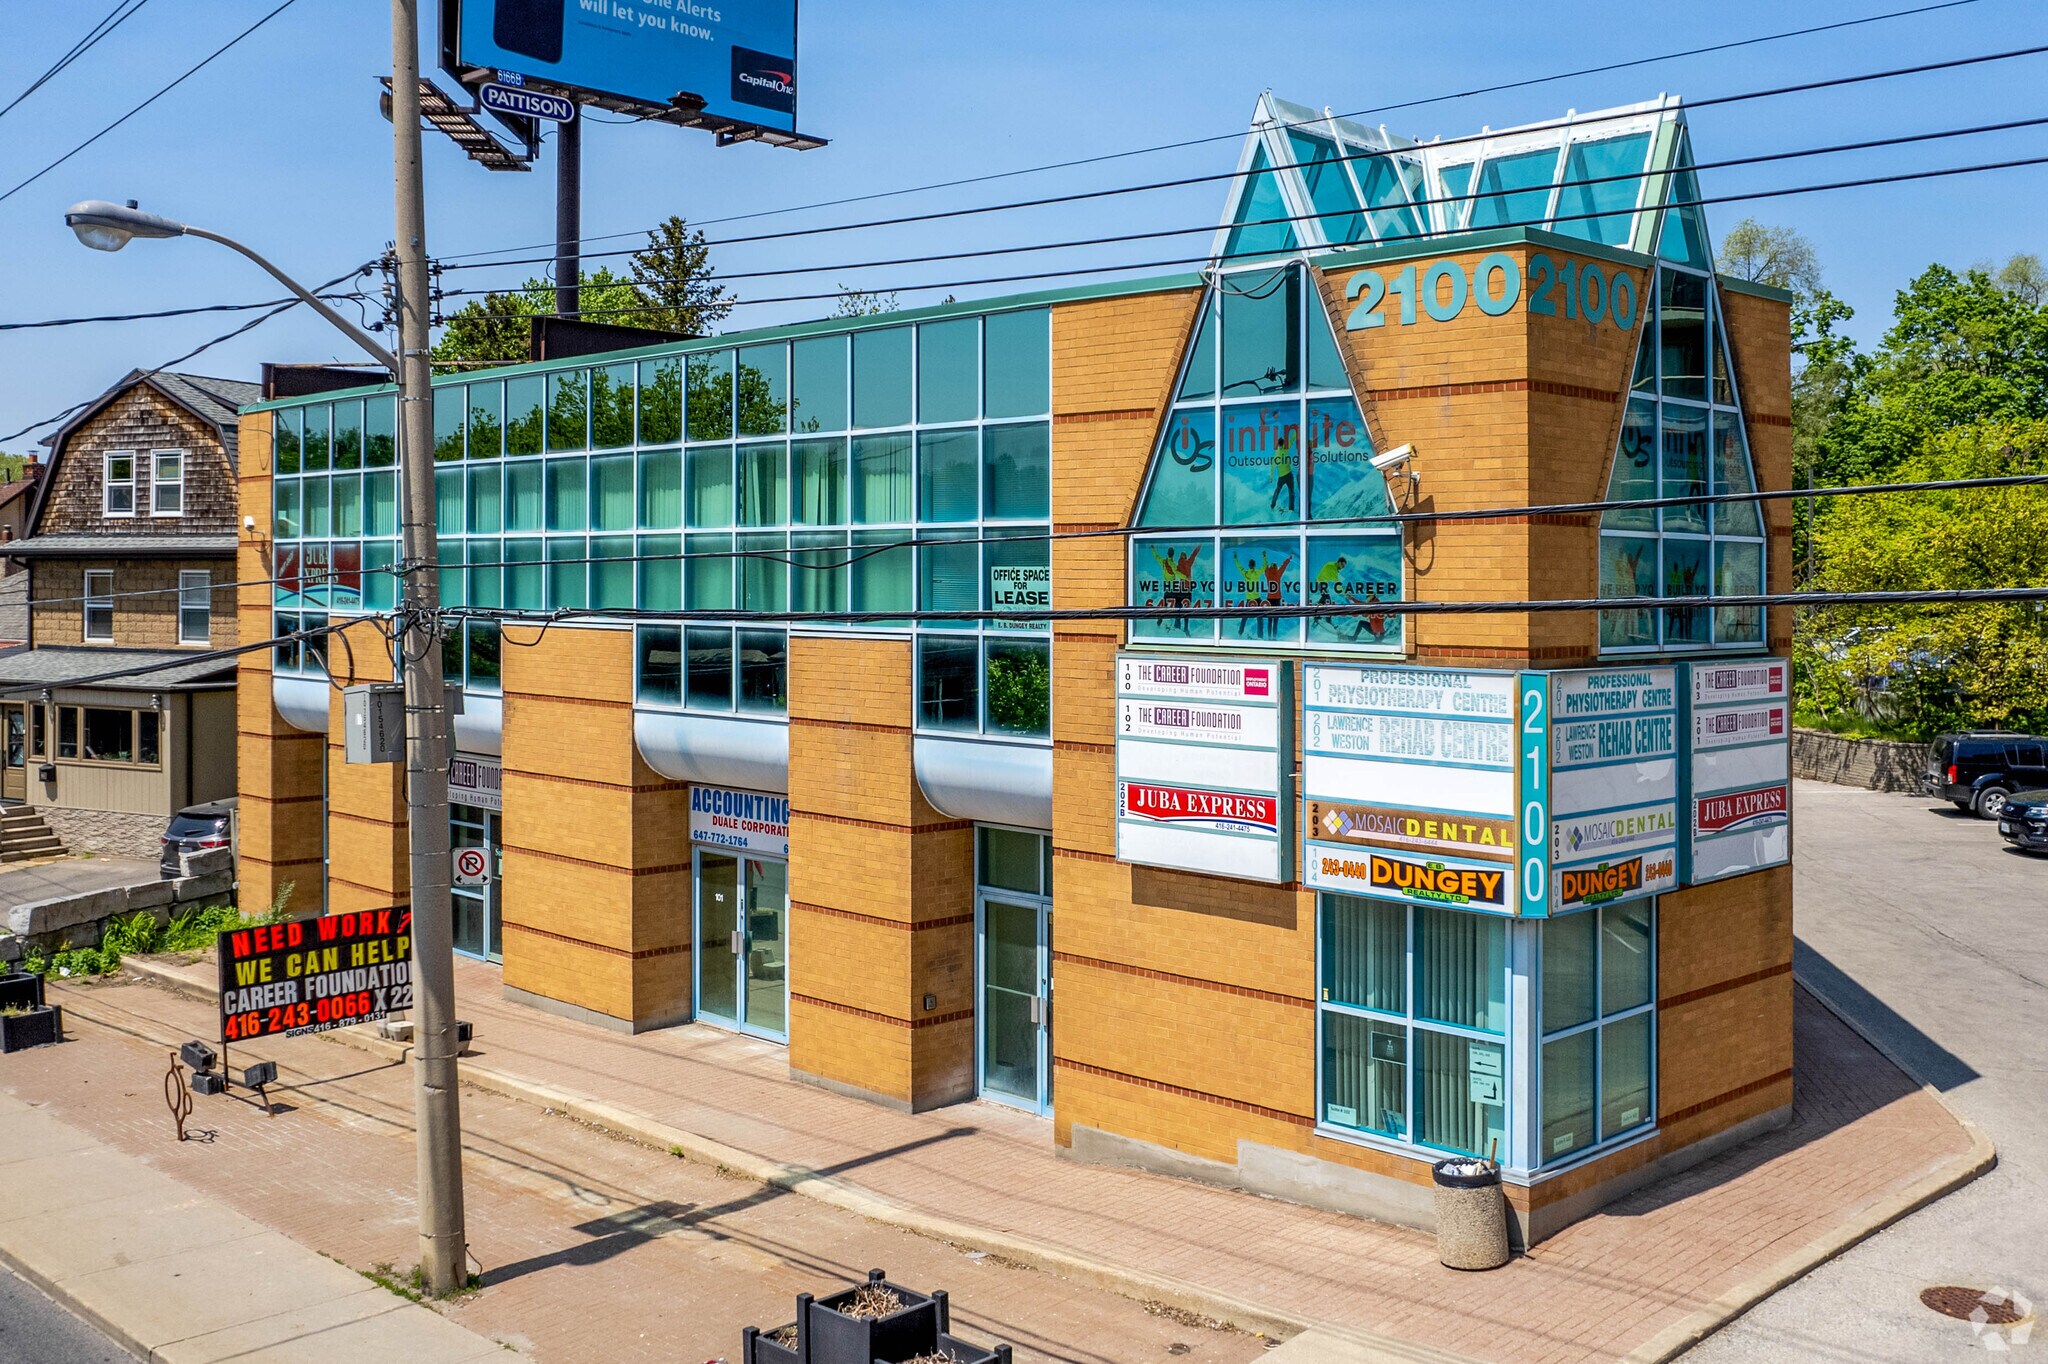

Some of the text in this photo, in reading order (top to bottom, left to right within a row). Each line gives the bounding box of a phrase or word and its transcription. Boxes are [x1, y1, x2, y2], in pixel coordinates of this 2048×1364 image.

[579, 0, 608, 15] will
[612, 0, 634, 22] let
[638, 11, 666, 29] you
[671, 16, 714, 41] know.
[676, 0, 721, 22] Alerts
[488, 88, 567, 117] PATTISON
[1345, 253, 1521, 331] 2100
[1528, 253, 1637, 330] 2100
[1228, 407, 1357, 453] infinite
[1228, 451, 1369, 468] Outsourcing Solutions
[993, 568, 1049, 581] OFFICE SPACE
[1013, 581, 1027, 590] FOR
[994, 591, 1049, 605] LEASE
[1140, 580, 1159, 592] WE
[1163, 580, 1197, 593] HELP
[1237, 581, 1278, 594] BUILD
[1333, 582, 1397, 595] CAREER
[1138, 665, 1241, 685] THE CAREER FOUNDATION
[1361, 669, 1472, 689] PROFESSIONAL
[1588, 673, 1652, 689] PROFESSIONAL
[1705, 672, 1714, 688] THE
[1328, 684, 1507, 714] PHYSIOTHERAPY CENTRE
[1566, 688, 1672, 713] PHYSIOTHERAPY CENTRE
[1138, 707, 1241, 730] THE CAREER FOUNDATION
[1327, 715, 1373, 733] LAWRENCE
[1705, 717, 1715, 733] THE
[1331, 733, 1370, 751] WESTON
[1379, 717, 1509, 763] REHAB CENTRE
[1566, 724, 1596, 742] LAWRENCE
[1598, 717, 1672, 758] REHAB CENTRE
[1569, 743, 1594, 761] WESTON
[692, 787, 790, 824] ACCOUNTING
[1137, 788, 1266, 820] JUBA EXPRESS
[1704, 789, 1781, 821] JUBA EXPRESS
[712, 815, 738, 829] DUALE
[1215, 822, 1250, 833] 416-241-4475
[693, 829, 748, 847] 647-772-1764
[1322, 857, 1367, 880] 243-0440
[1371, 857, 1502, 900] DUNGEY
[1563, 857, 1641, 900] DUNGEY
[1407, 888, 1464, 902] REALTY LTD.
[232, 922, 303, 958] NEED
[235, 935, 410, 986] WE CAN HELP
[224, 980, 298, 1015] CAREER
[225, 991, 371, 1040] 416-243-0066
[374, 989, 387, 1011] X
[286, 1025, 314, 1038] SIGNS
